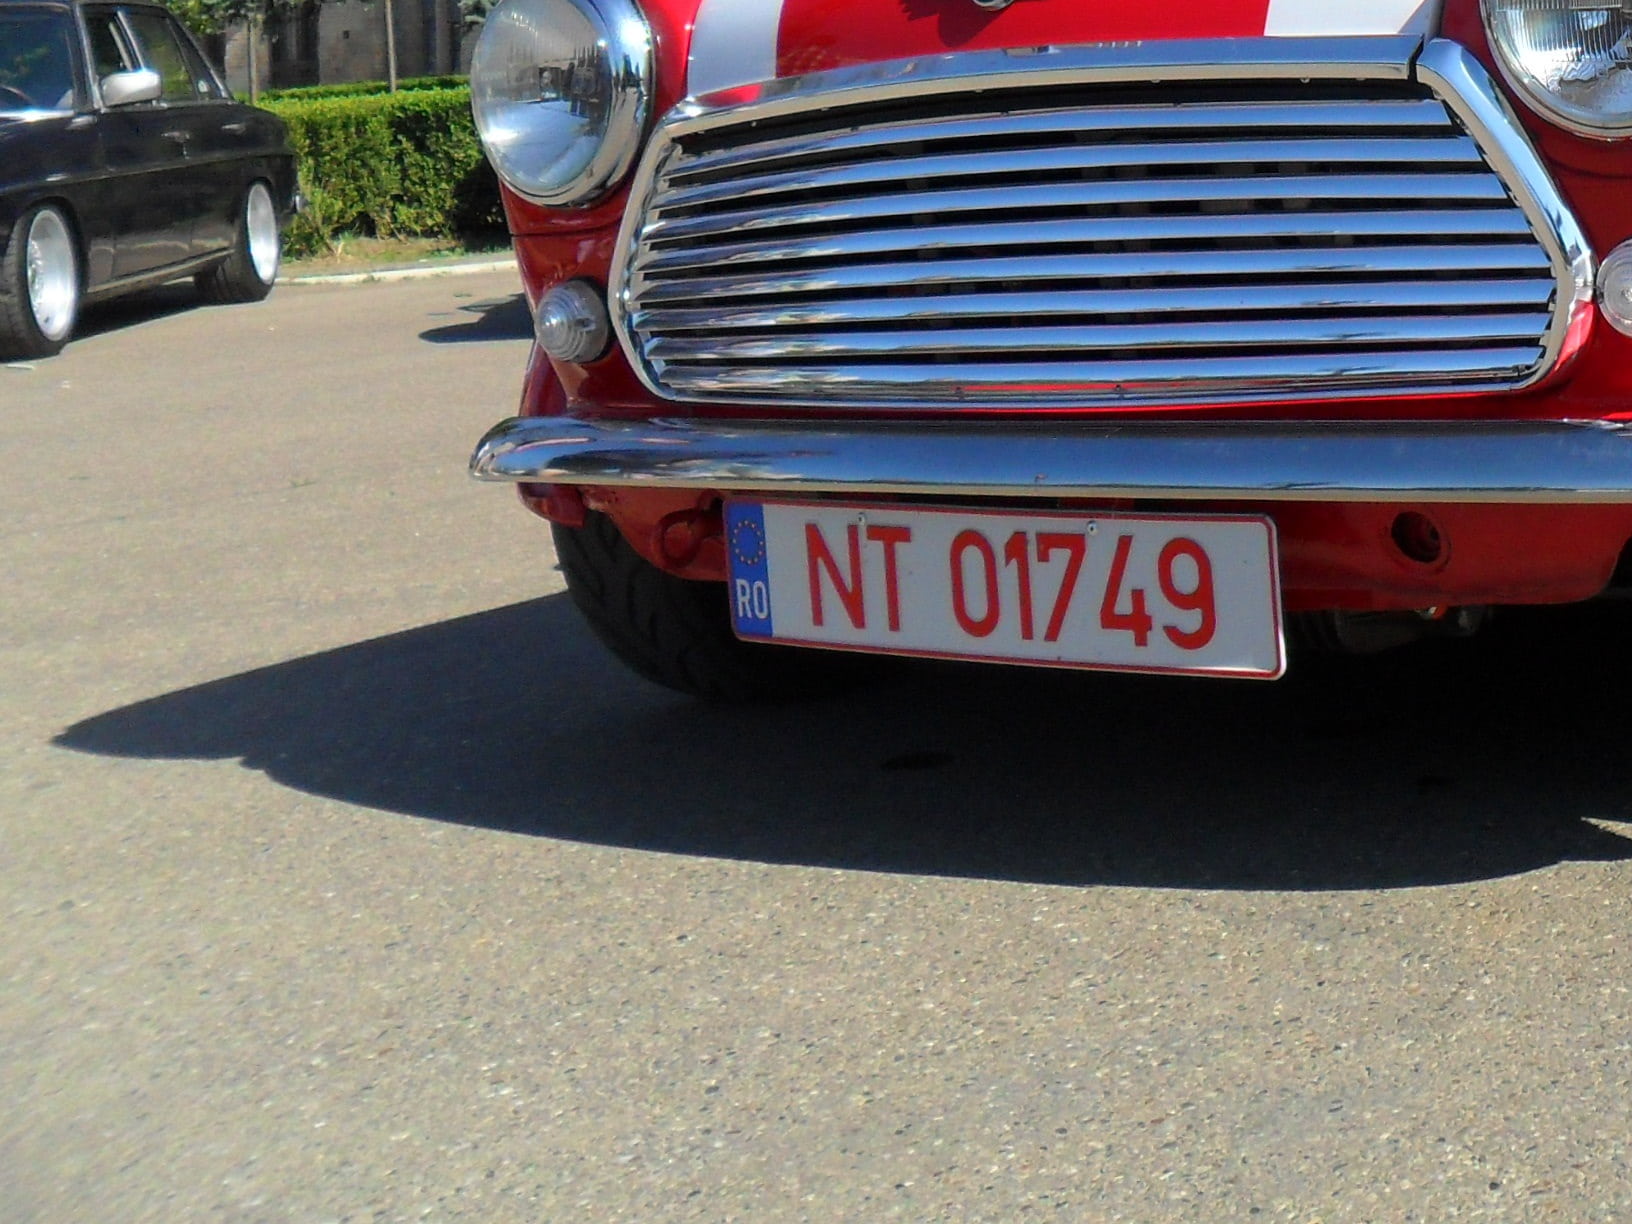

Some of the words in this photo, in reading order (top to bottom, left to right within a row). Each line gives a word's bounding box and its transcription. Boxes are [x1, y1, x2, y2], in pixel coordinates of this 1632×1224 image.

[736, 578, 769, 621] RO
[804, 522, 912, 632] NT
[949, 528, 1218, 650] 01749
